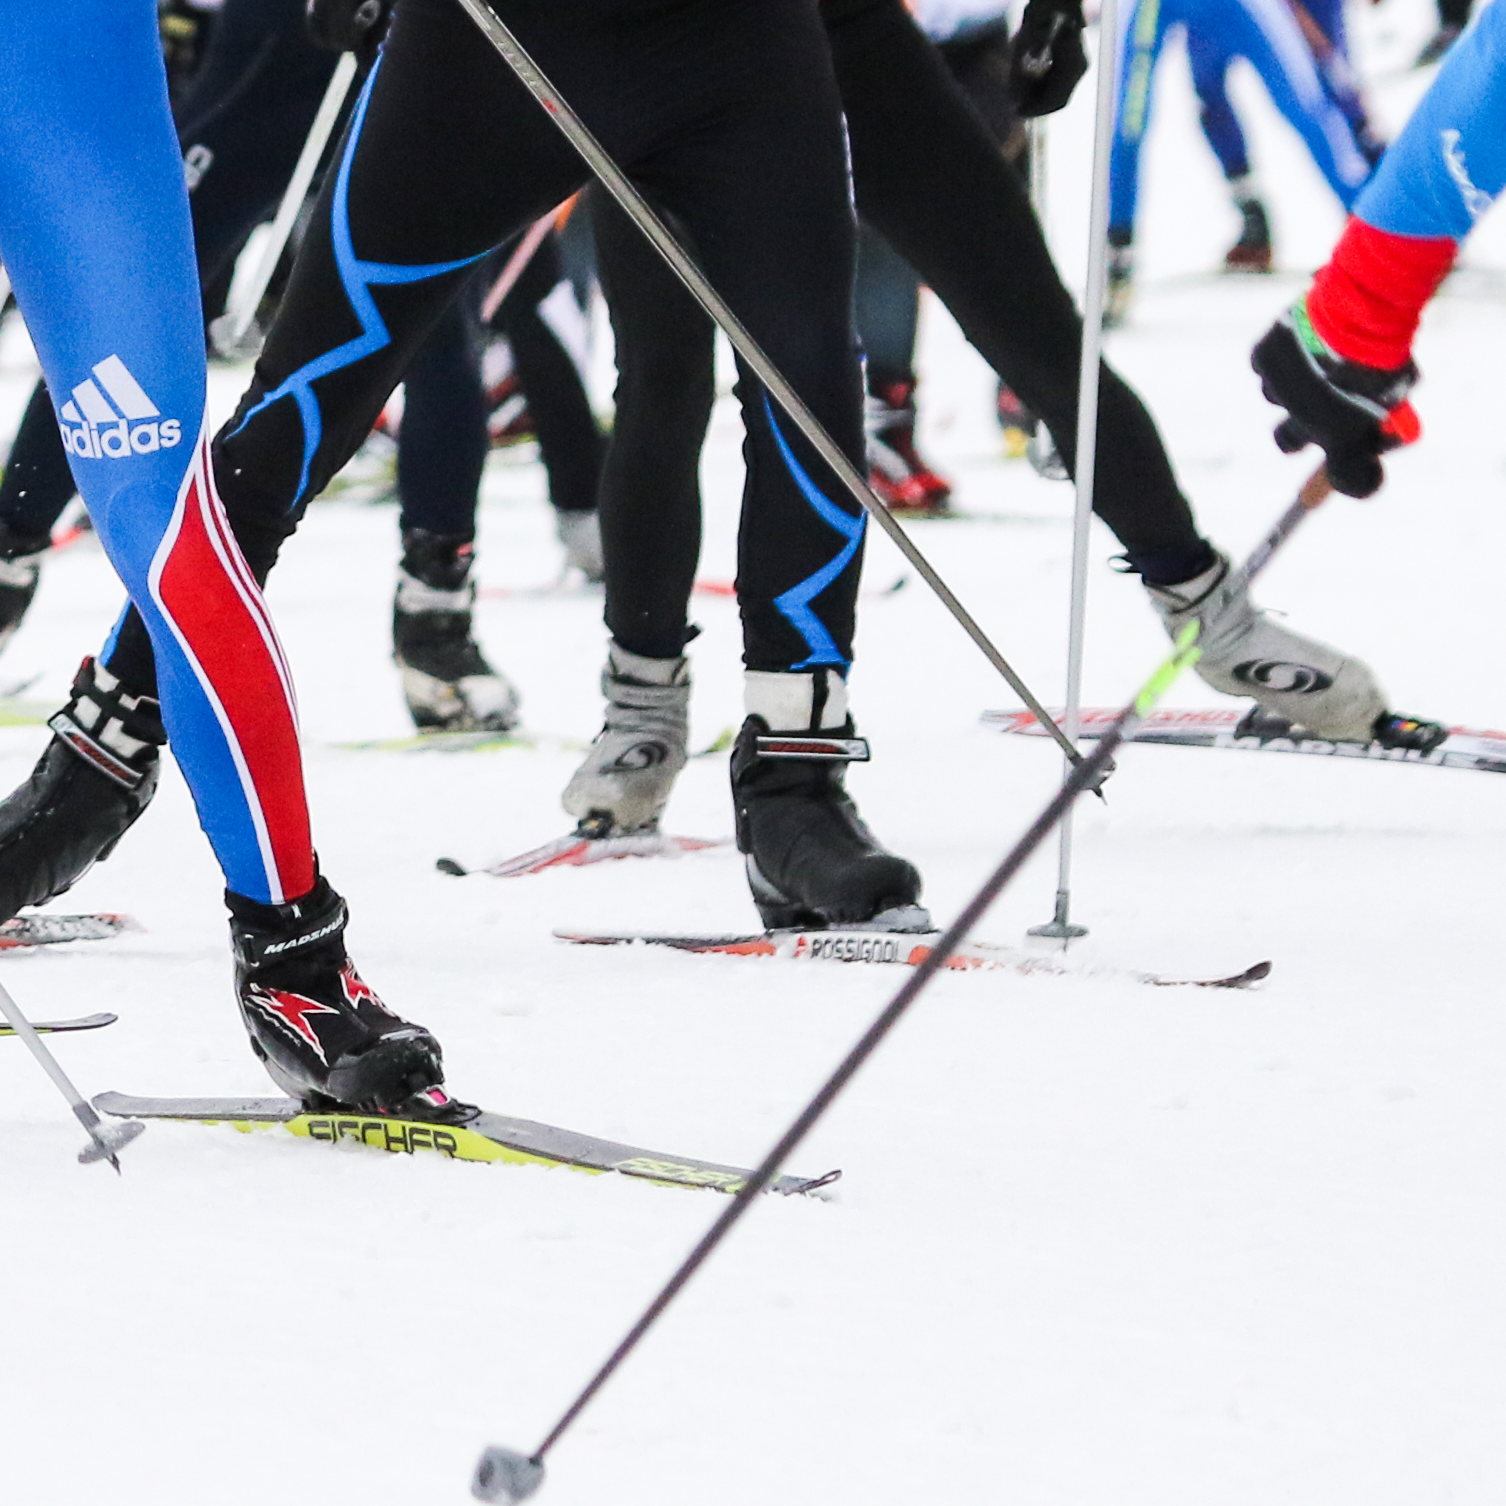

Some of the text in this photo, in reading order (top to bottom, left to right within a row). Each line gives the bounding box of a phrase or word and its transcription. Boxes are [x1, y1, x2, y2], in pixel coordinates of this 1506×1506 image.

[60, 417, 183, 460] adidas
[811, 938, 900, 962] ROSSIGNOL
[308, 1119, 458, 1158] FISCHER
